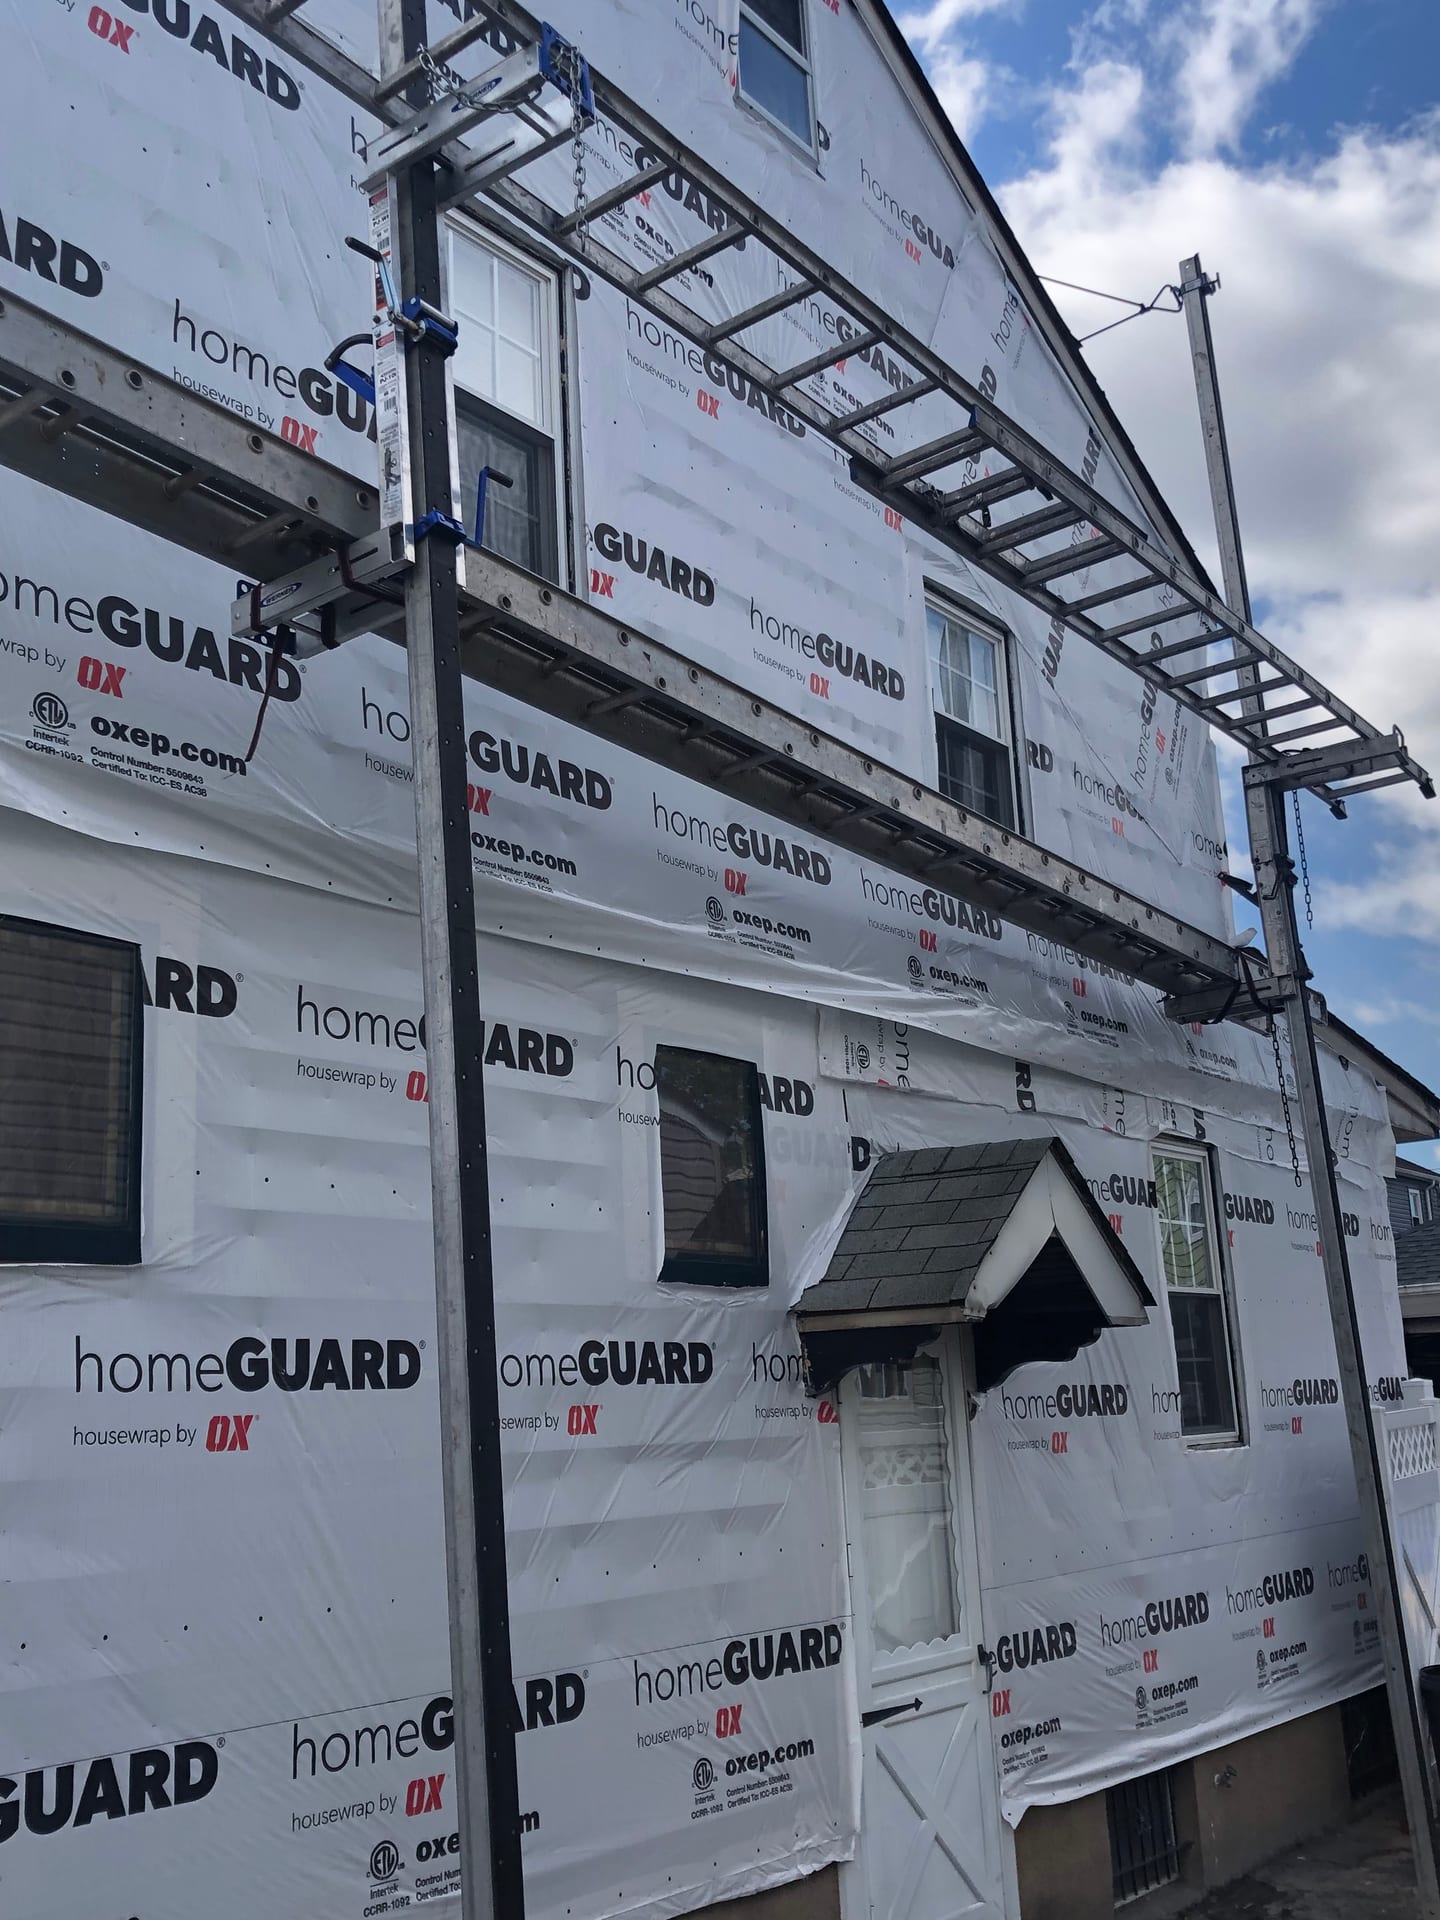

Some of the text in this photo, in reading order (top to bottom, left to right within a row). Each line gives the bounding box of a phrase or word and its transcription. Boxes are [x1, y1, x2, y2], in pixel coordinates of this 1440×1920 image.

[87, 5, 135, 55] OX
[627, 348, 720, 420] housewrap by OX
[172, 365, 320, 456] housewrap by OX
[884, 507, 904, 534] OX
[750, 596, 906, 701] homeGUARD
[45, 647, 66, 673] by
[77, 655, 127, 699] OX
[753, 648, 830, 700] housewrap by OX
[90, 715, 247, 776] oxep.com
[90, 746, 125, 764] Control
[126, 756, 165, 774] Number:
[91, 758, 132, 777] Certified
[133, 768, 148, 782] To:
[149, 773, 183, 792] ICC-ES
[471, 831, 577, 876] oxep.com
[653, 791, 832, 886] homeGUARD
[656, 849, 748, 896] housewrap by OX
[860, 867, 1003, 941] homeGUARD
[733, 909, 812, 943] oxep.com
[919, 928, 937, 953] OX
[296, 1059, 430, 1103] housewrap by O
[1001, 1384, 1128, 1420] homeGUARD
[1260, 1378, 1339, 1408] homeGUARD
[545, 1410, 560, 1431] by
[567, 1404, 599, 1436] OX
[755, 1403, 801, 1421] housewrap
[802, 1403, 813, 1421] by
[1291, 1416, 1303, 1435] OX
[73, 1415, 254, 1452] housewrap by OX
[1051, 1431, 1069, 1454] OX
[1226, 1566, 1314, 1616] homeGUARD
[1100, 1591, 1210, 1648] homeGUARD
[1262, 1616, 1276, 1639] OX
[634, 1623, 842, 1706] homeGUARD
[1143, 1648, 1159, 1674] OX
[1269, 1640, 1308, 1664] oxep.com
[992, 1689, 1012, 1718] OX
[1152, 1675, 1199, 1701] oxep.com
[637, 1703, 743, 1749] housewrap by OX
[1001, 1717, 1062, 1748] oxep.com
[725, 1738, 815, 1778] oxep.com
[291, 1773, 446, 1833] housewrap by OX
[415, 1873, 443, 1889] Control
[363, 1895, 411, 1918] CCRR-1092
